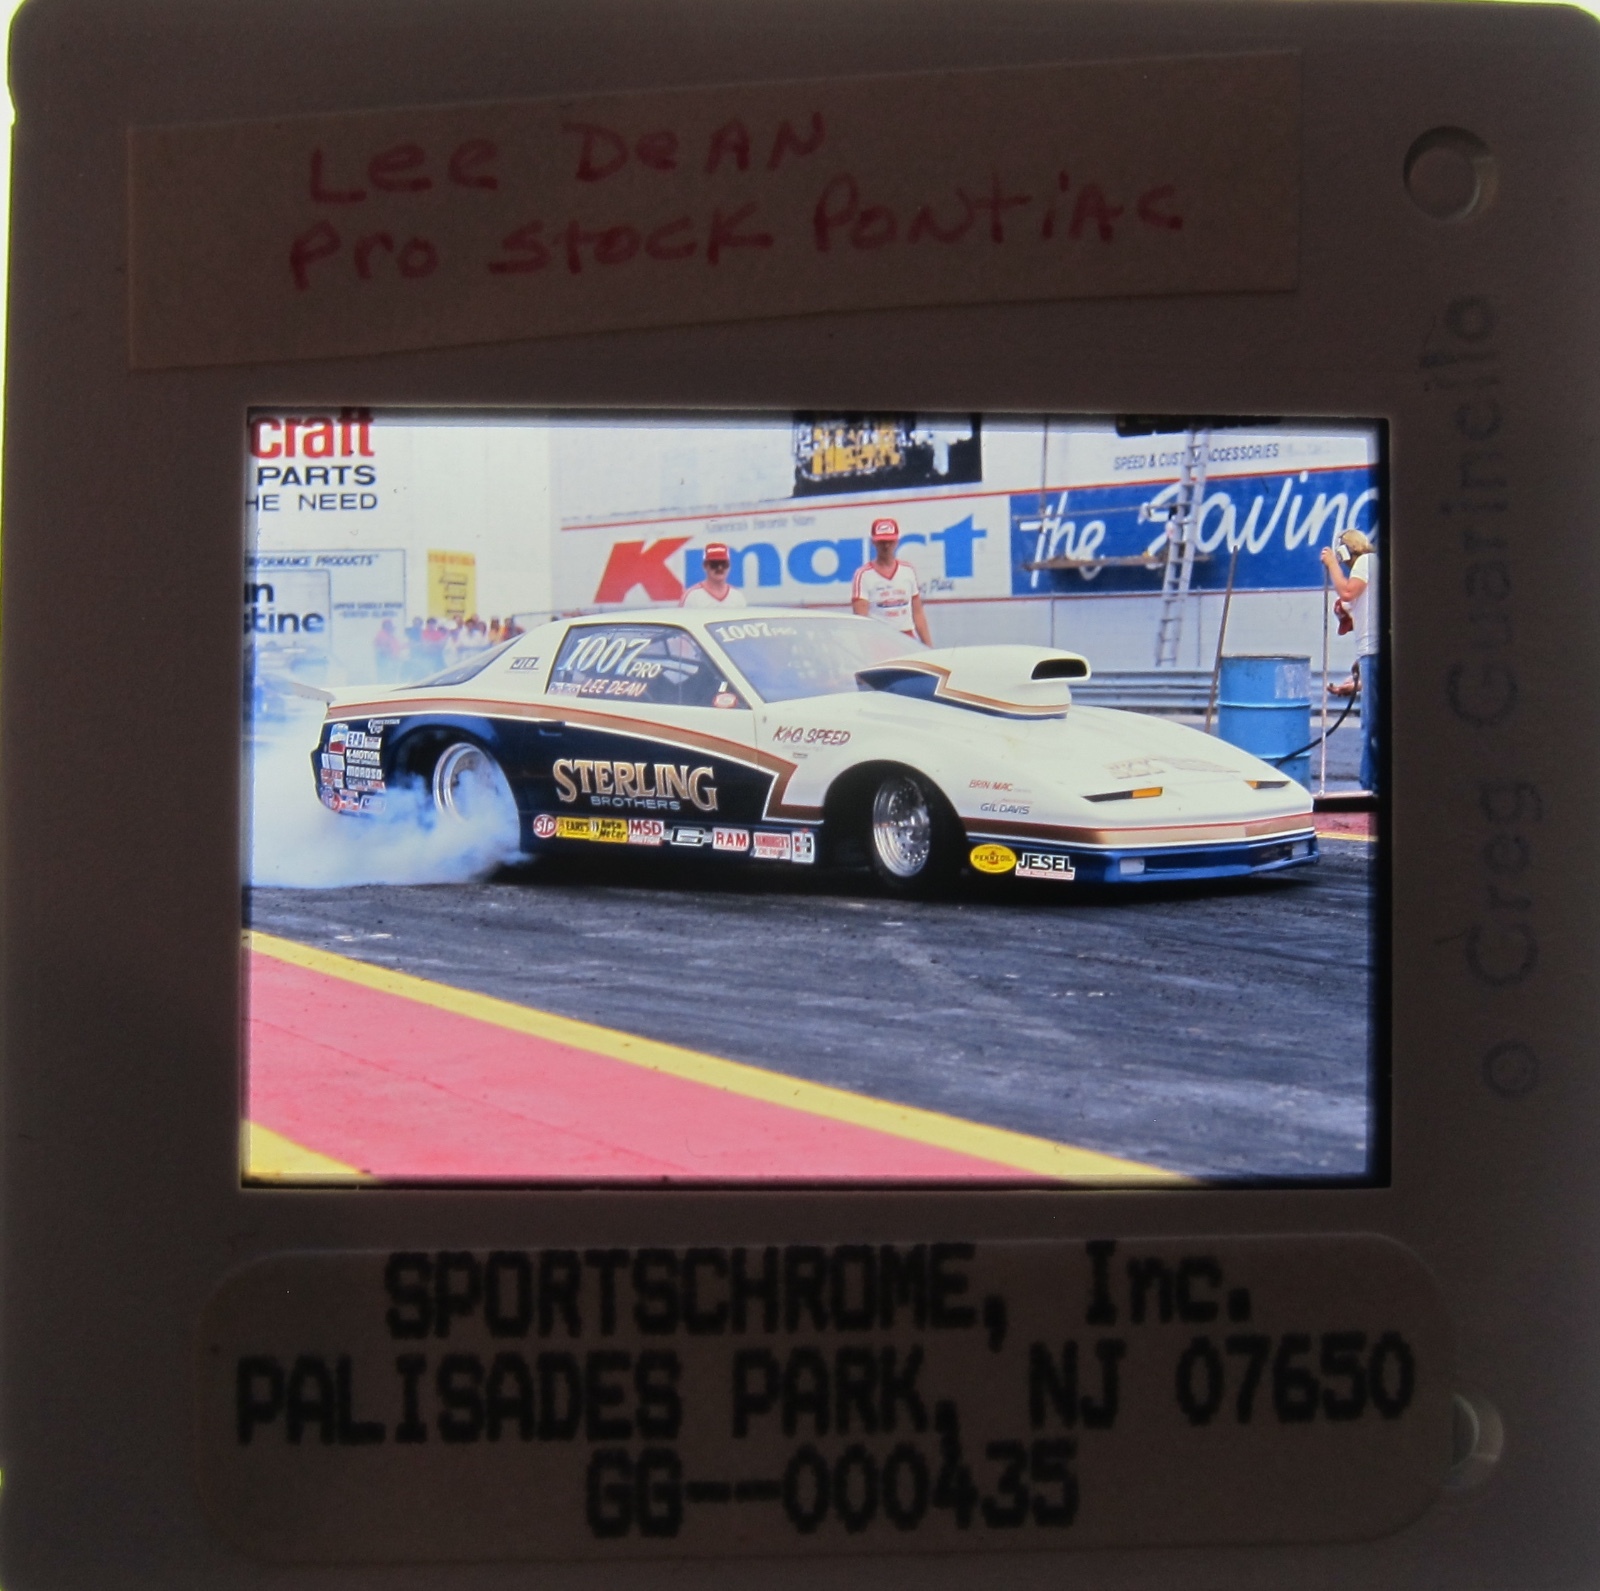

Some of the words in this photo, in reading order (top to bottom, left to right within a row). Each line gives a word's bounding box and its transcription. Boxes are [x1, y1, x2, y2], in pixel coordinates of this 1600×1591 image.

[307, 137, 499, 203] Lee
[257, 464, 376, 486] PARTS
[298, 493, 378, 511] NEED
[716, 622, 772, 642] 1007
[556, 635, 652, 676] 1007
[626, 661, 662, 679] PRO
[581, 678, 609, 694] LEE
[605, 679, 648, 697] DEAN
[804, 727, 851, 746] SPEED
[552, 758, 719, 812] STERLING
[992, 781, 1014, 792] MAC
[590, 795, 681, 811] BROTHERS
[980, 802, 998, 813] GIL
[1000, 804, 1030, 815] DAVIS
[535, 817, 555, 834] STP
[630, 819, 662, 836] MSD
[715, 831, 747, 847] RAM
[1019, 854, 1074, 873] JESEL
[384, 1243, 1007, 1353] SPORTSCHROME,
[1086, 1239, 1252, 1326] Inc.
[236, 1349, 683, 1445] PALISADES
[732, 1344, 961, 1446] PARK,
[1028, 1338, 1127, 1429] NJ
[1176, 1331, 1415, 1426] 07650
[585, 1436, 1079, 1538] GG--000435
